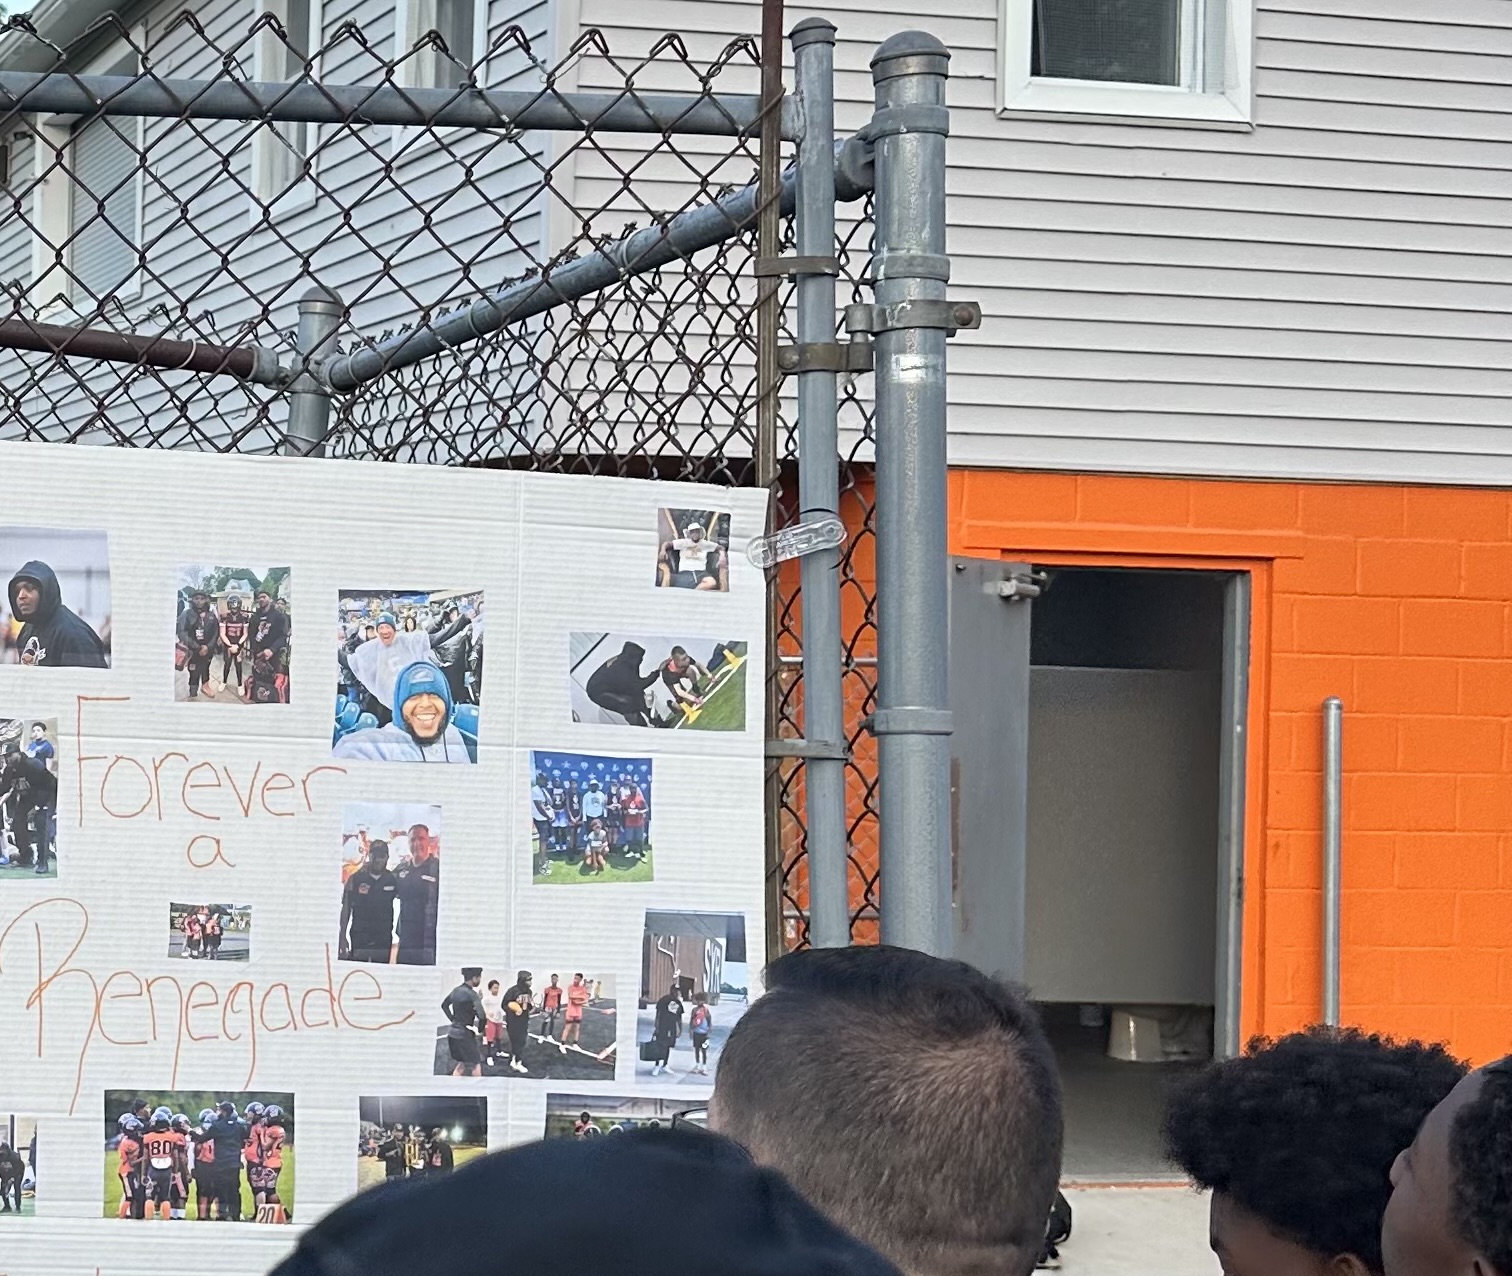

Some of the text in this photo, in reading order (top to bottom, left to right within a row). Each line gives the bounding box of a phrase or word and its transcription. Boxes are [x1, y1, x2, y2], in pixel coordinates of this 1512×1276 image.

[77, 695, 347, 827] Forever
[187, 834, 236, 868] a
[151, 1139, 173, 1156] 80
